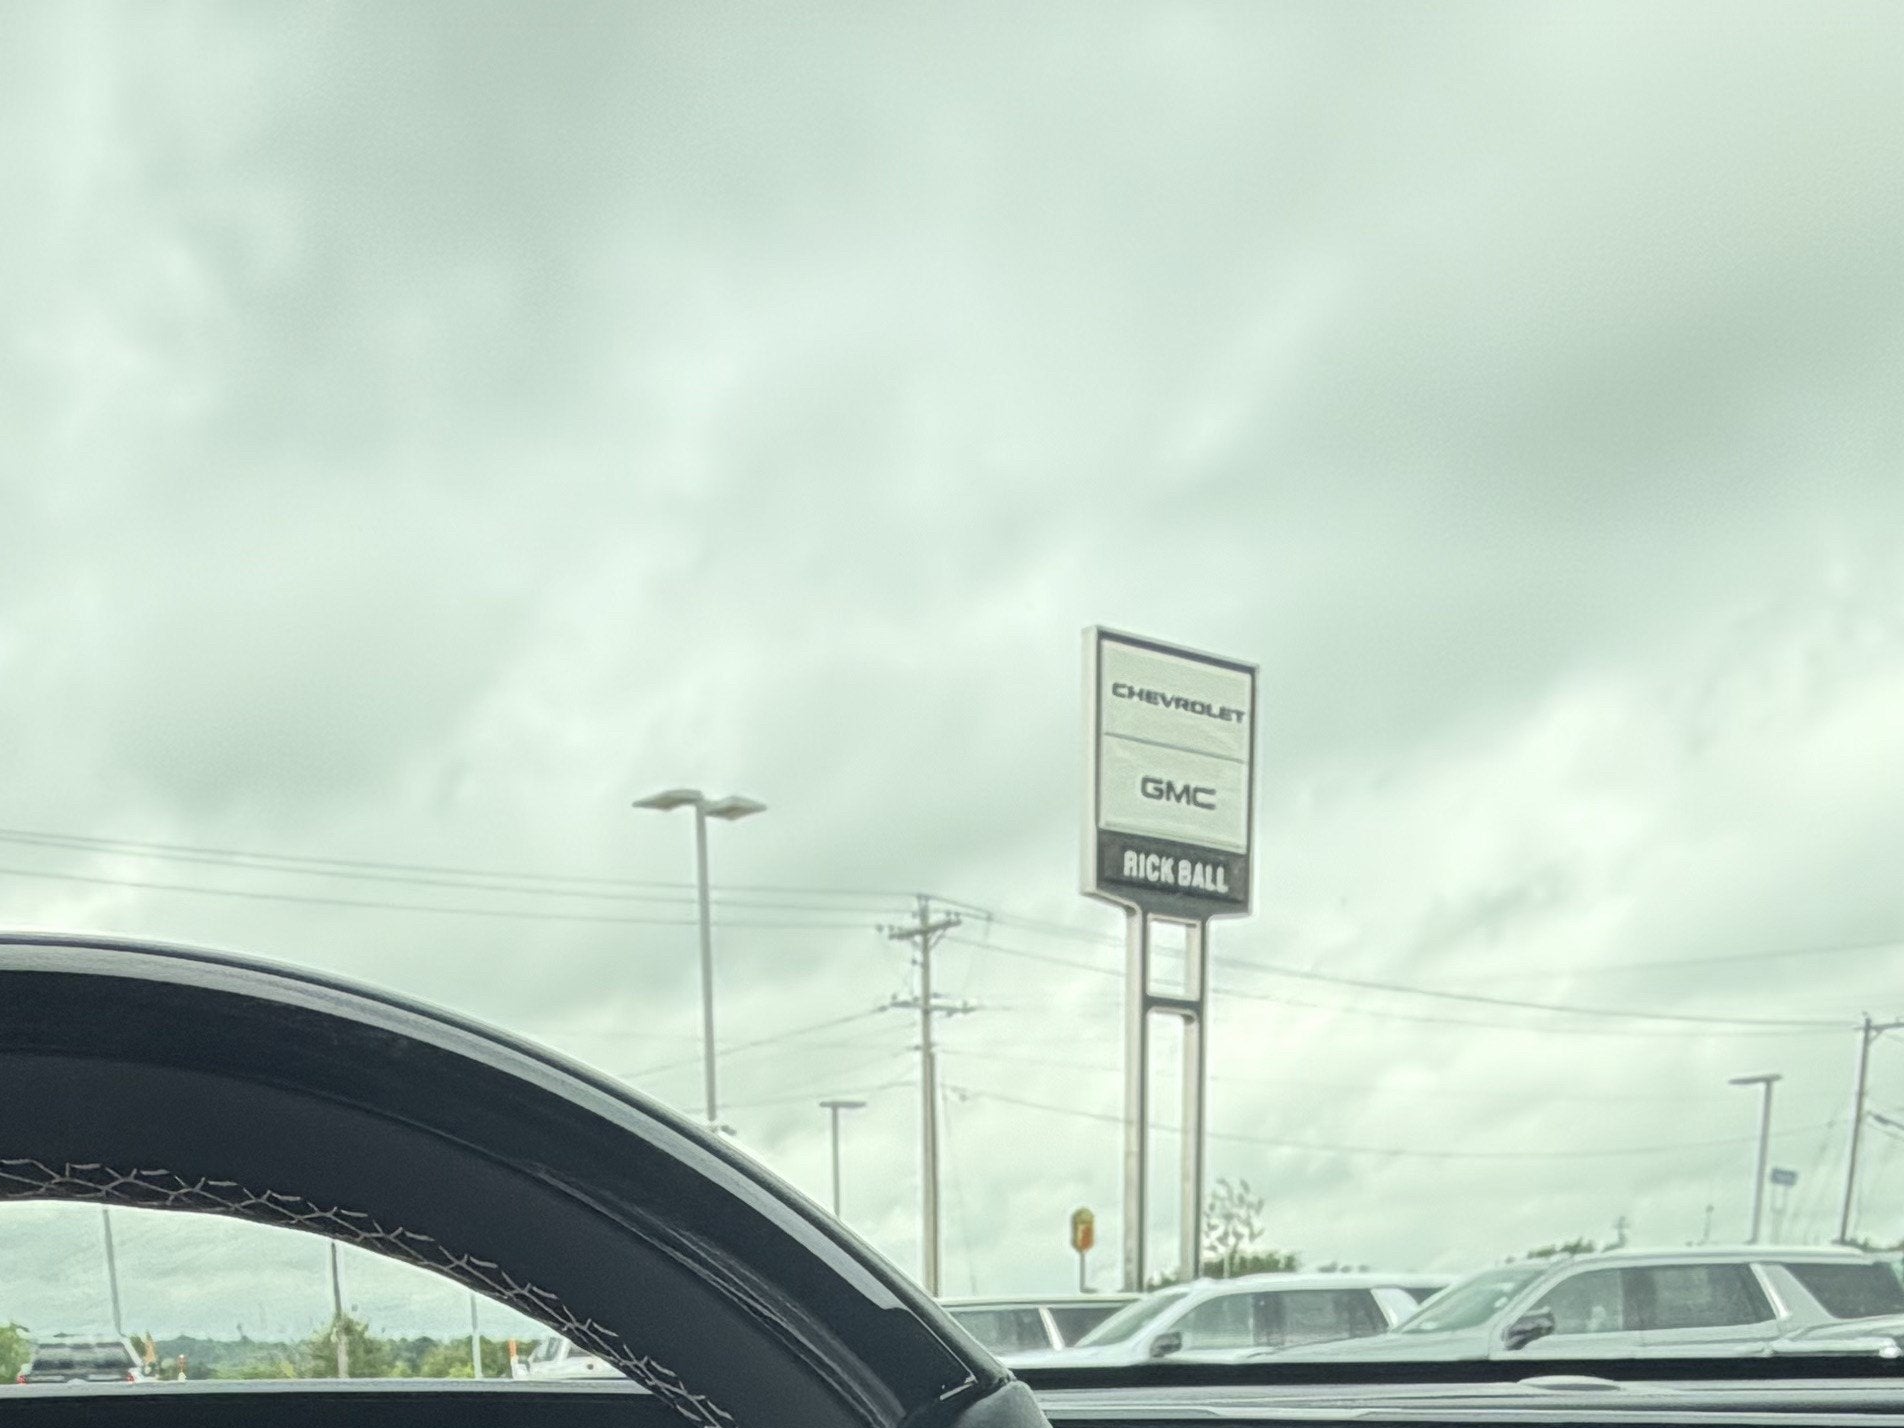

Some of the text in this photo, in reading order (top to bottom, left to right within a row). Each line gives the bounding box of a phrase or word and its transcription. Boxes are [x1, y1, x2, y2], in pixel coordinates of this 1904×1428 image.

[1111, 681, 1246, 724] CHEVROLET
[1140, 775, 1217, 810] GMC
[1123, 850, 1229, 894] RICK BALL
